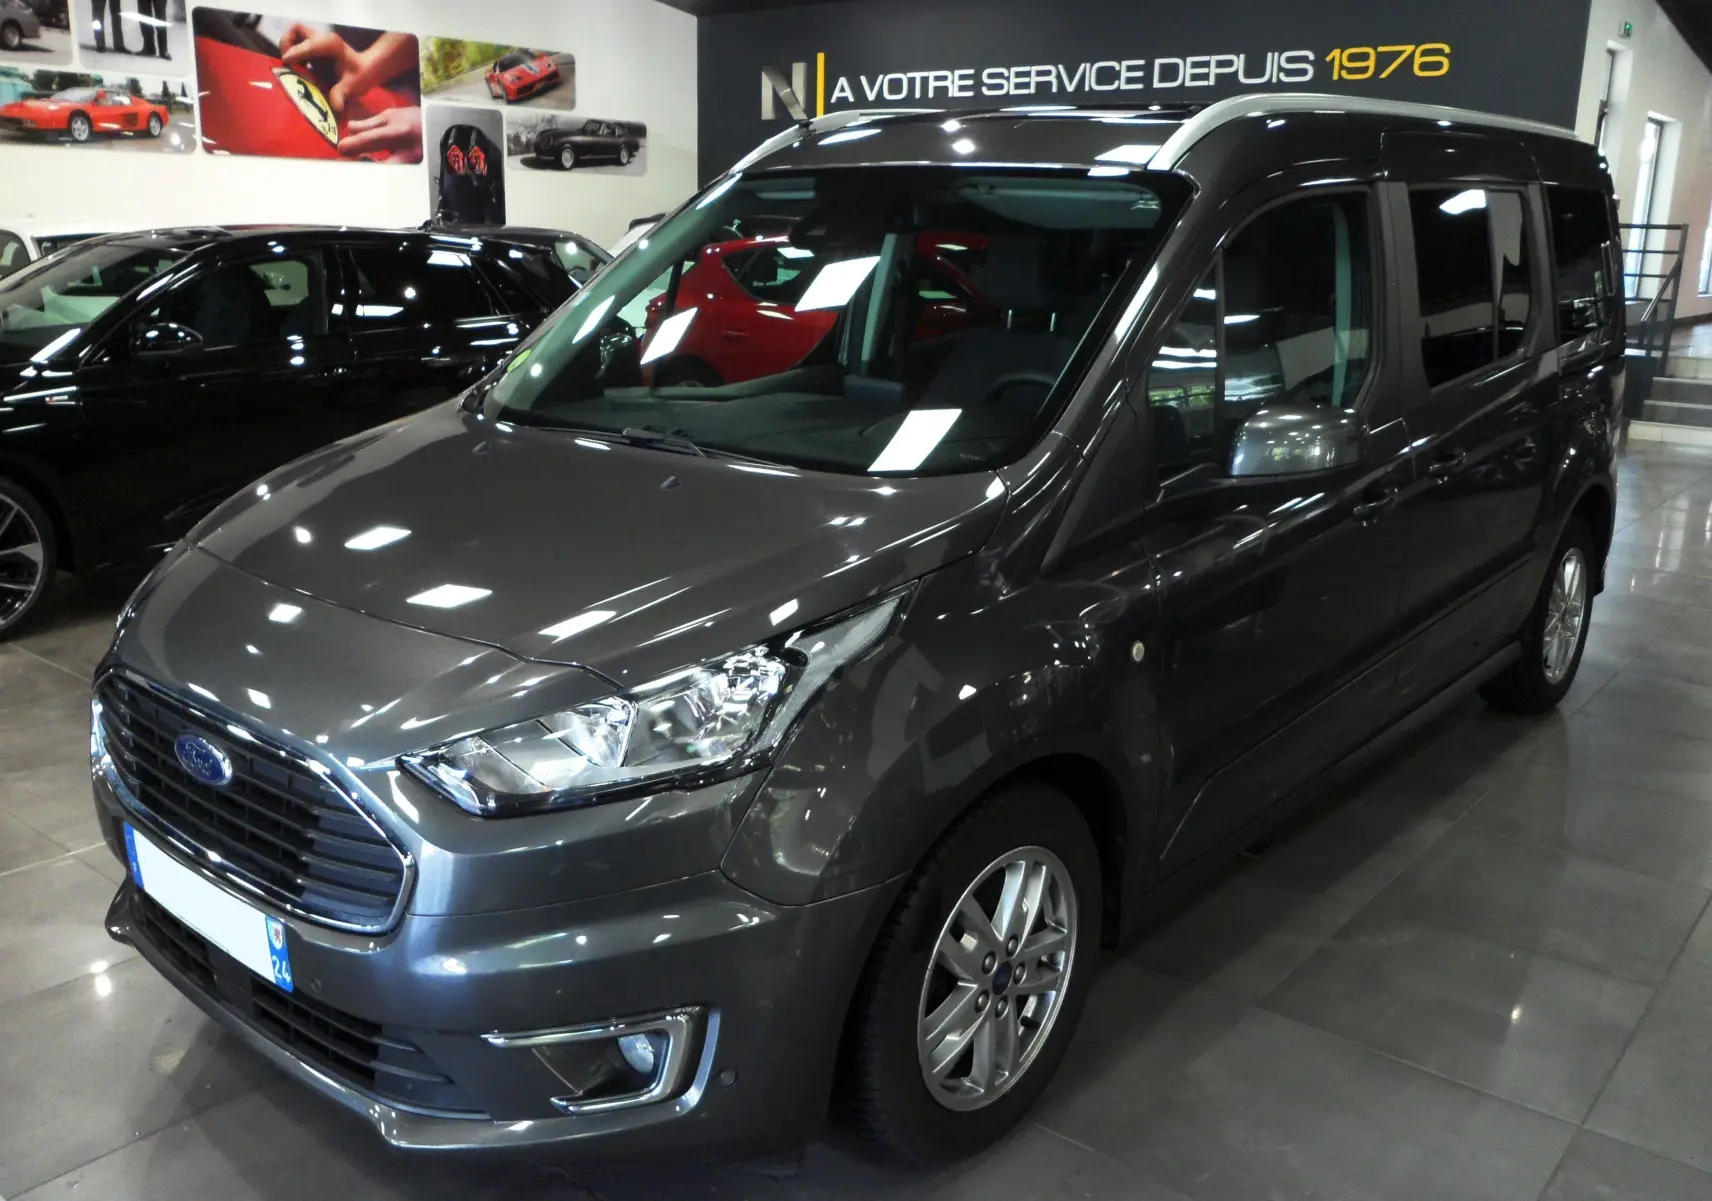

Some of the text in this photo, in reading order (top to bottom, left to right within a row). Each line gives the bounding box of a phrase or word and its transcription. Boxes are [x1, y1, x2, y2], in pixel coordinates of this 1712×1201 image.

[831, 43, 1452, 103] A VOTRE SERVICE DEPUIS 1976
[271, 954, 291, 983] 24
